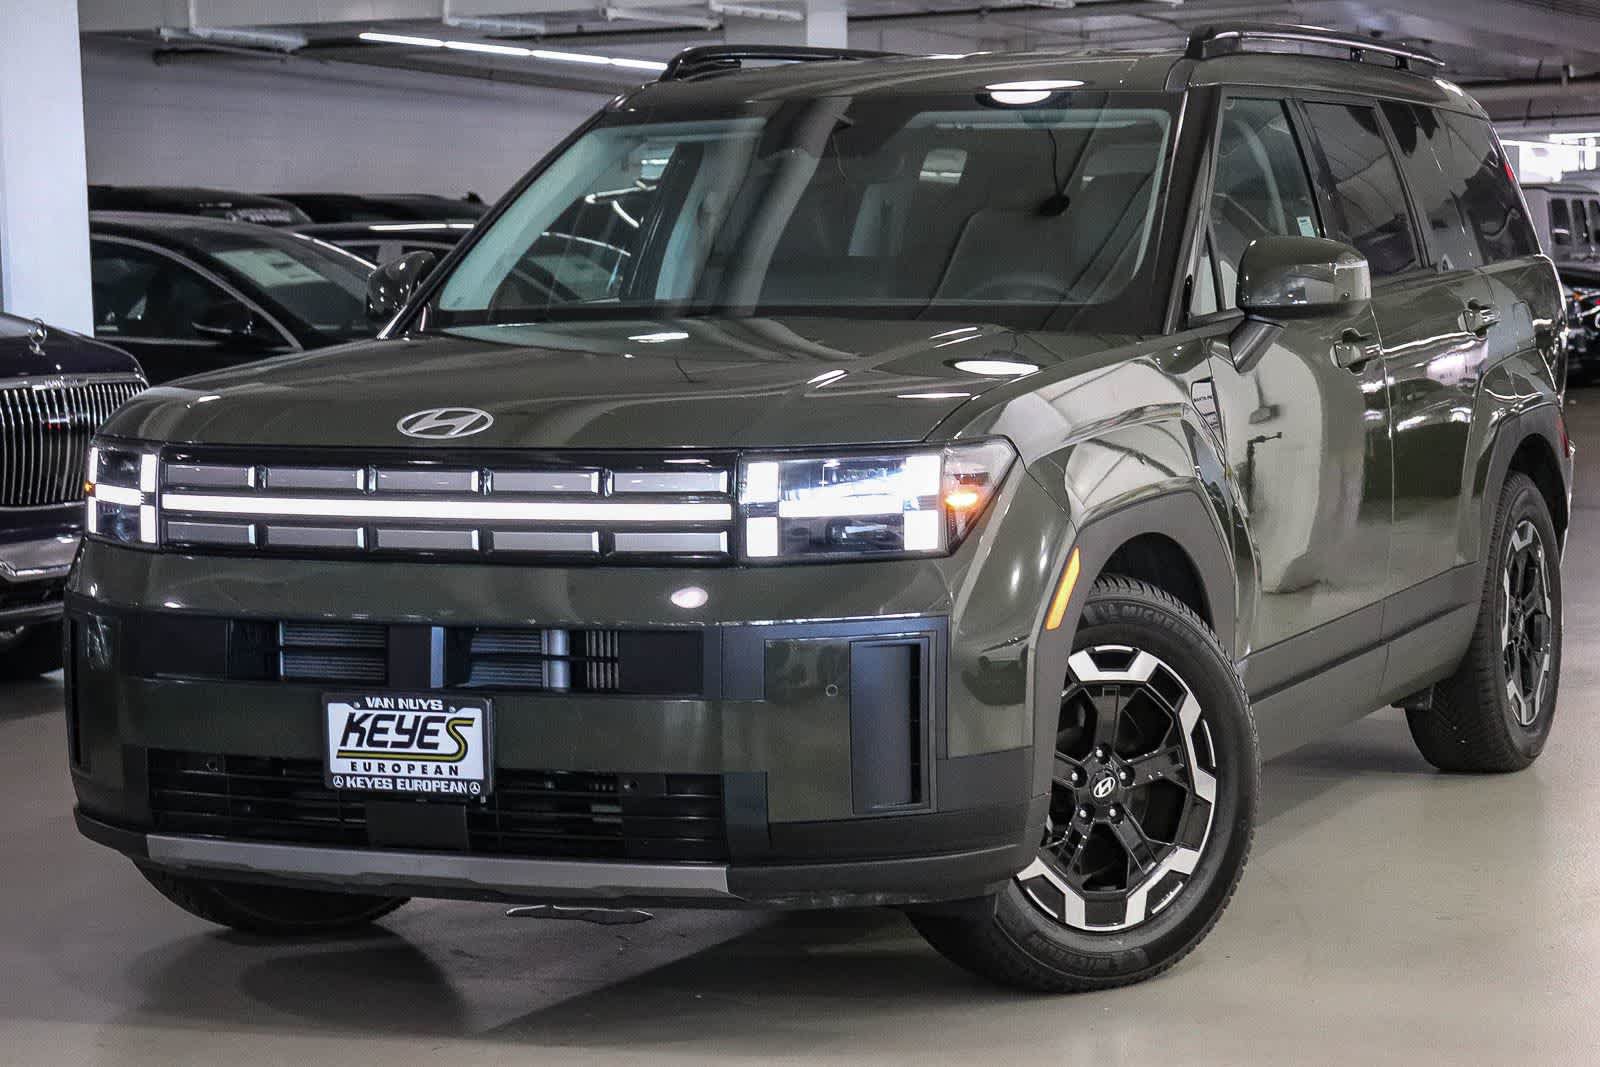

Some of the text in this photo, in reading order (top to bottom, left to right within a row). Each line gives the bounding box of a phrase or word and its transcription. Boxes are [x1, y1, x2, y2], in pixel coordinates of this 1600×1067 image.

[366, 697, 443, 711] VAN NUYS
[339, 712, 475, 763] KEYES
[350, 762, 459, 776] EUROPEAN
[346, 776, 468, 794] KEYES EUROPEAN
